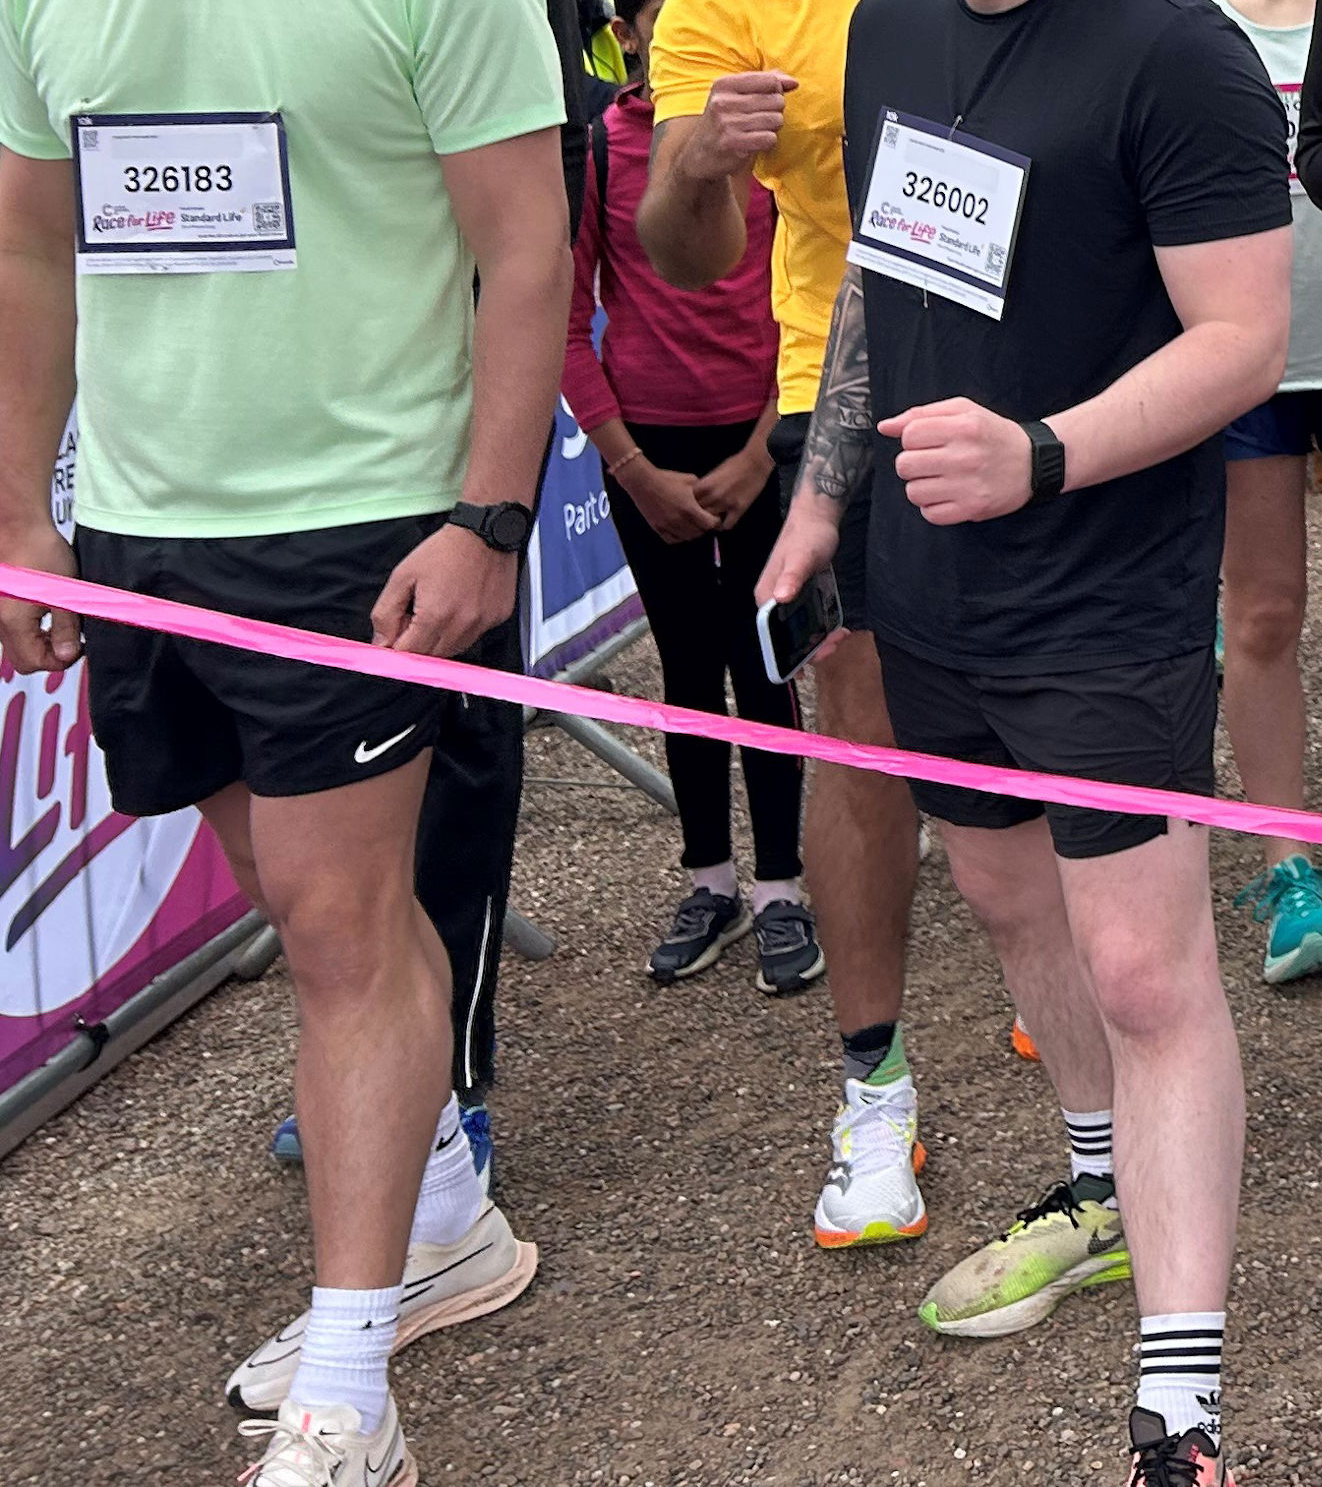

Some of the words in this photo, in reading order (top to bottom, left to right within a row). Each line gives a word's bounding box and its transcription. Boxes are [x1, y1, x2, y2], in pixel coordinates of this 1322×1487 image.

[124, 165, 233, 193] 326183
[902, 171, 990, 225] 326002
[92, 215, 126, 233] Race
[127, 215, 145, 228] for
[145, 210, 176, 229] Life
[180, 212, 223, 223] Standard
[223, 212, 243, 223] Life
[564, 491, 600, 541] Part
[597, 489, 611, 520] o
